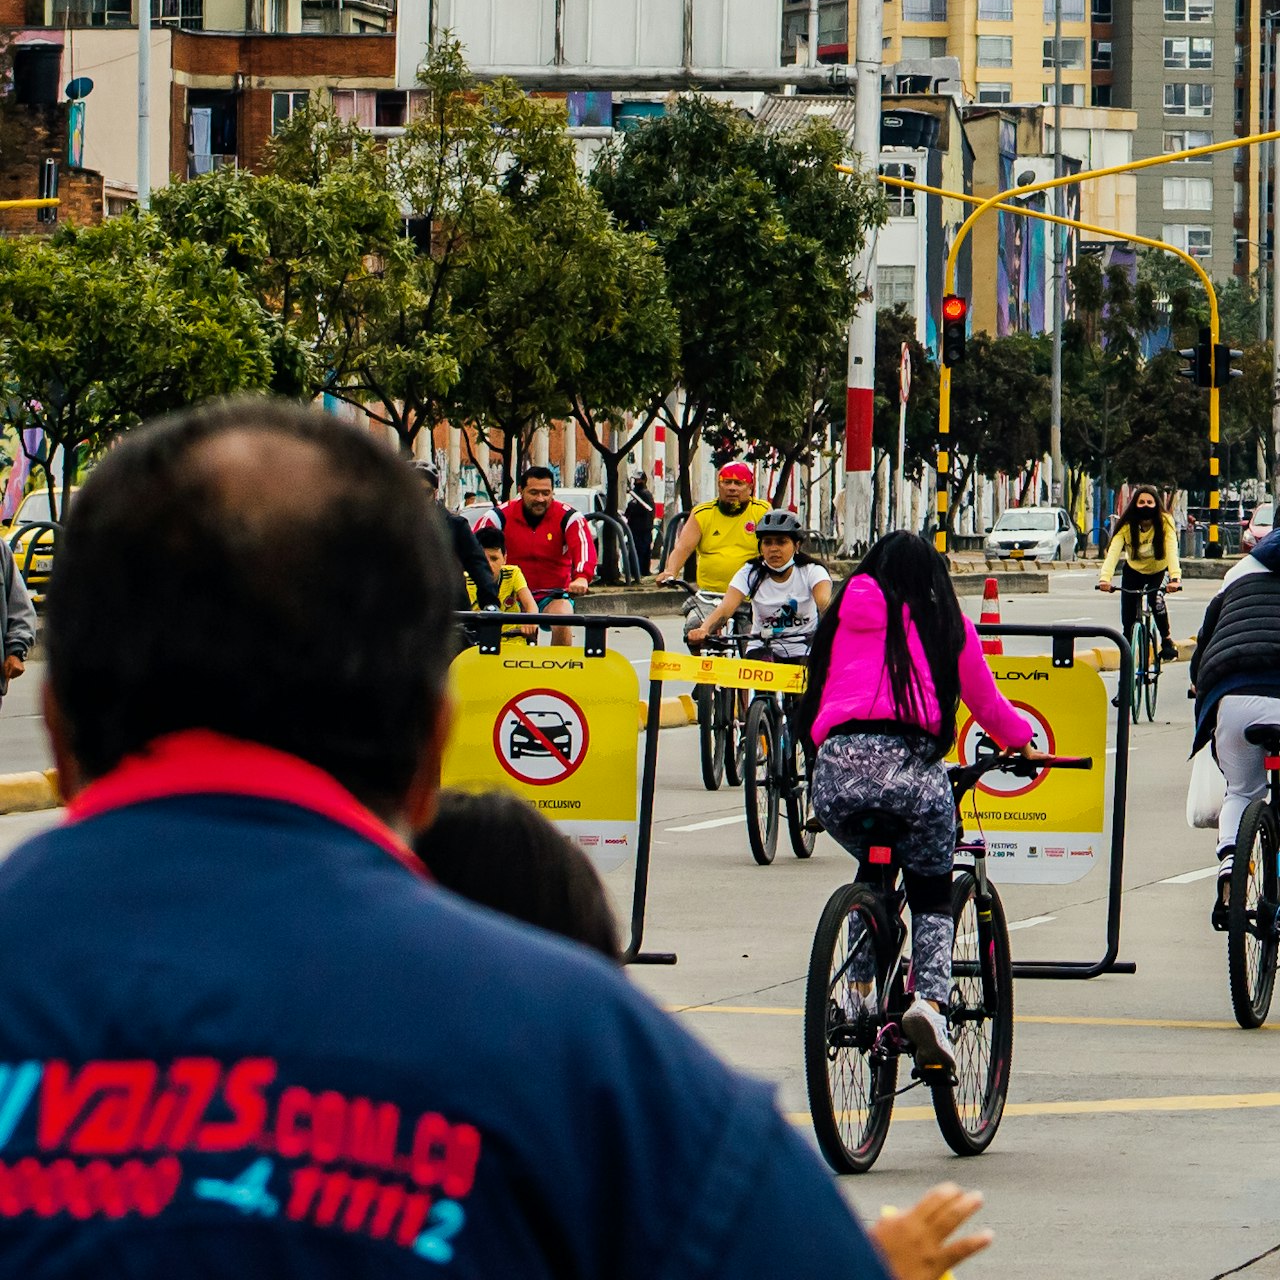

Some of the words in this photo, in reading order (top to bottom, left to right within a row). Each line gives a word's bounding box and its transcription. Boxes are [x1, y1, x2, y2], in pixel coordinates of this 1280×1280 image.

[738, 667, 774, 682] IDRD
[538, 800, 581, 809] EXCLUSIVO
[1003, 811, 1047, 820] EXCLUSIVO
